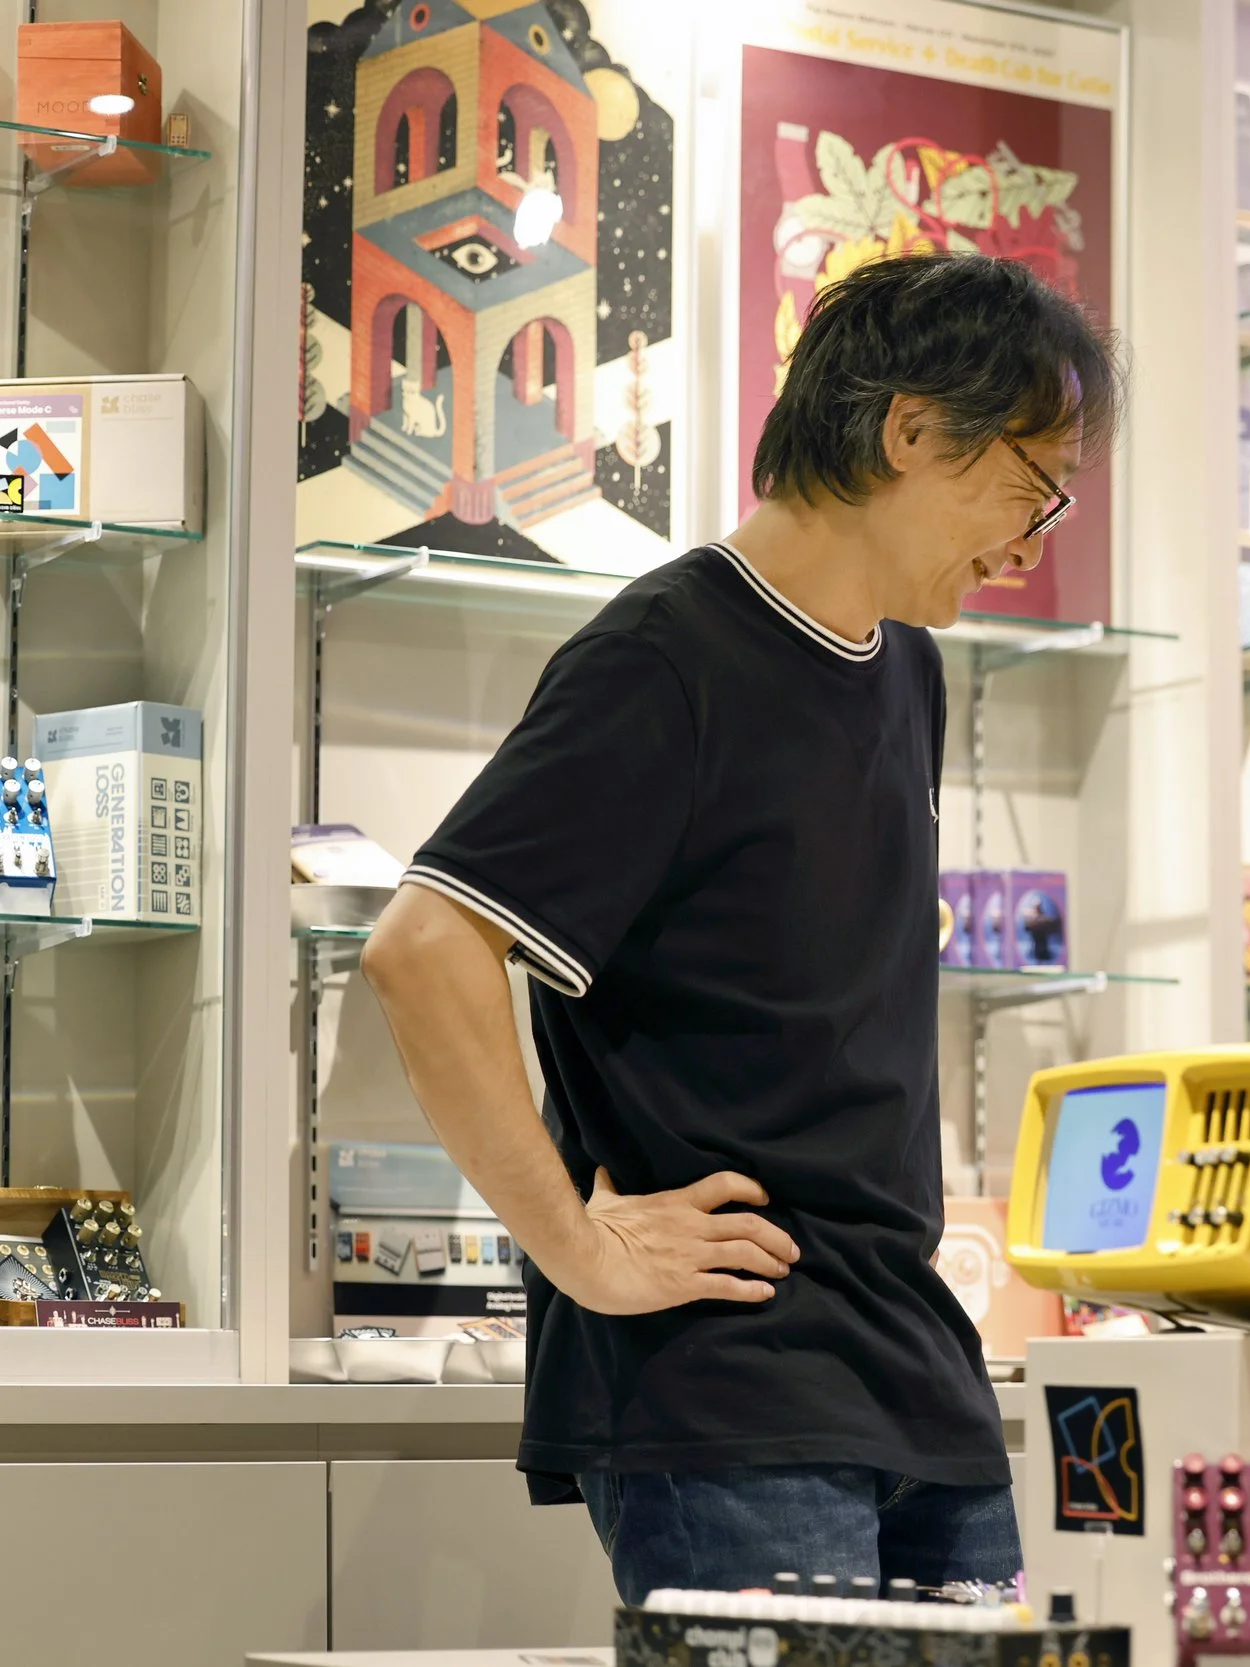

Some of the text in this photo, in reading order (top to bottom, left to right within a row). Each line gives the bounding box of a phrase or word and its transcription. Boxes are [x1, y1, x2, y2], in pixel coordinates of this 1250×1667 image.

[18, 405, 43, 414] Mode
[44, 405, 52, 414] C
[96, 765, 109, 818] LOSS
[111, 763, 125, 912] GENERATION
